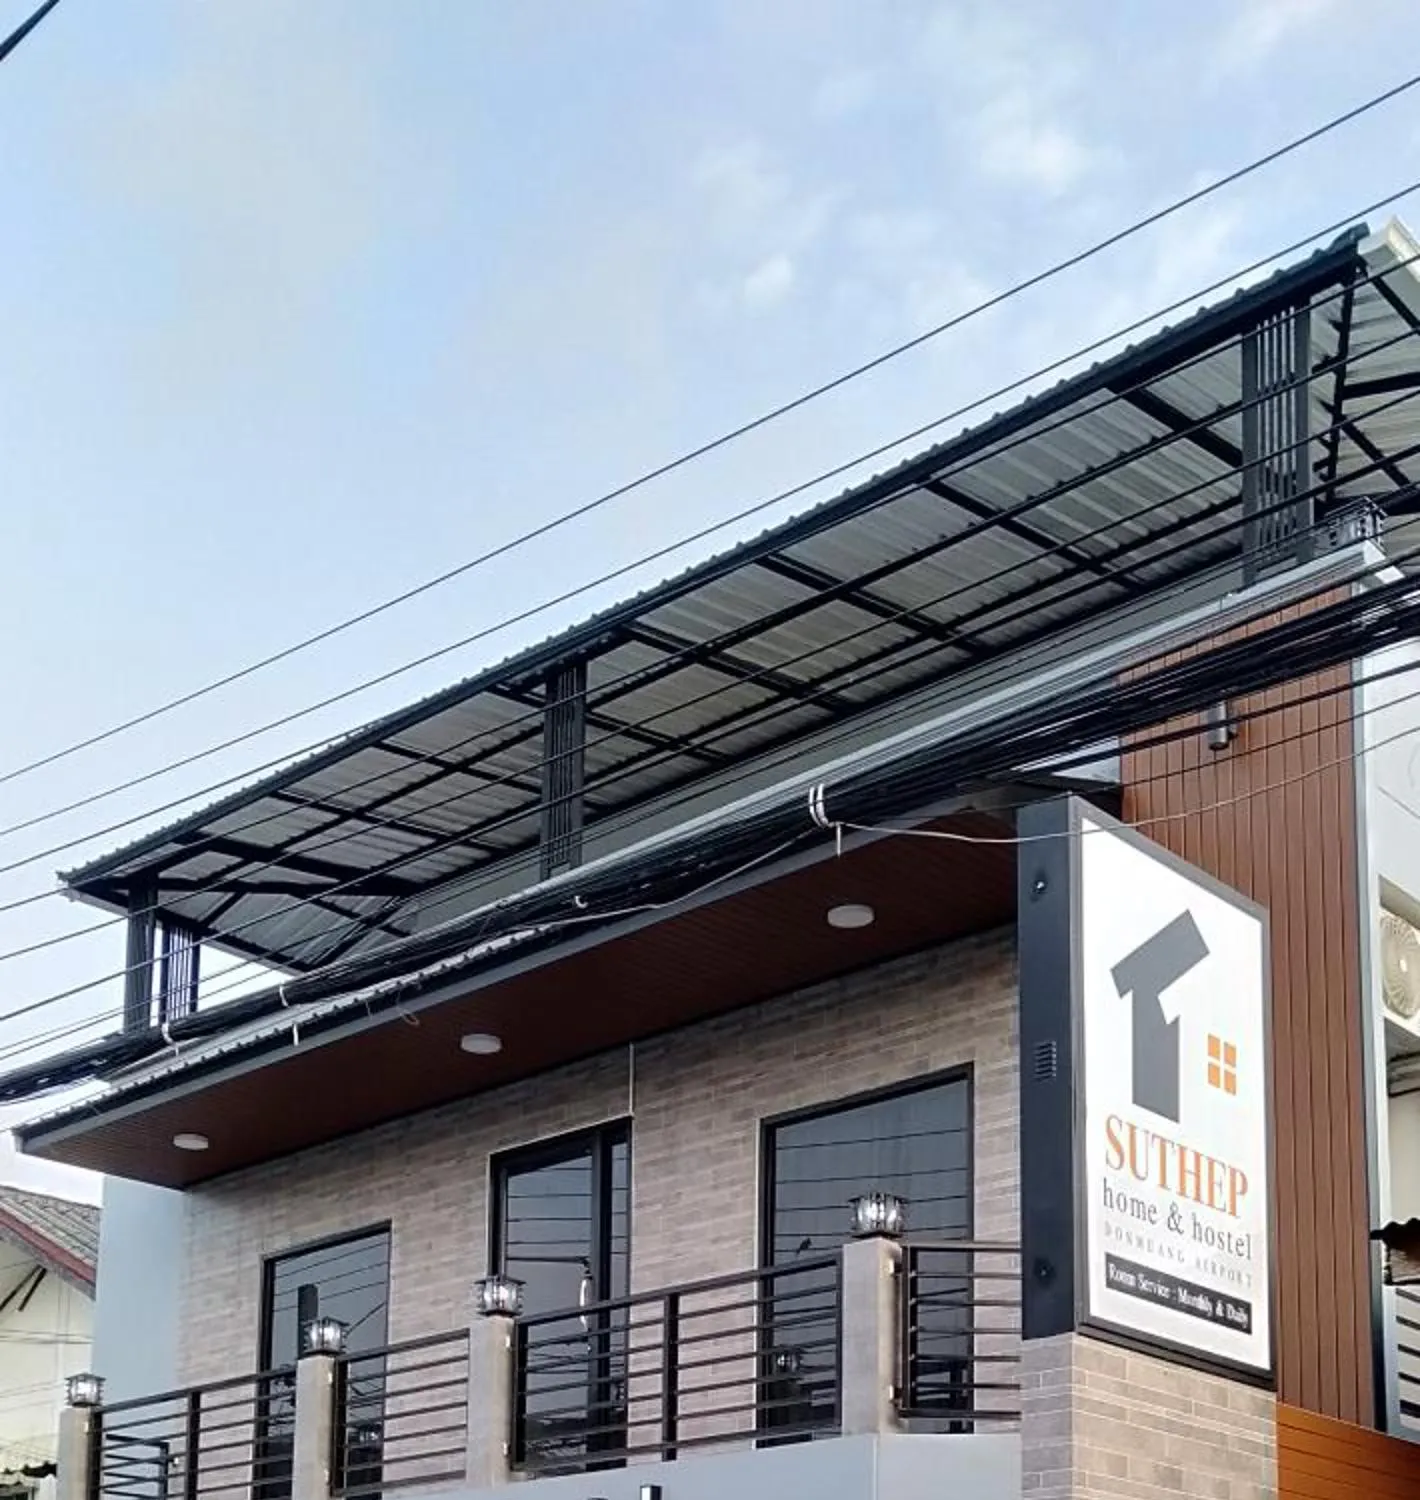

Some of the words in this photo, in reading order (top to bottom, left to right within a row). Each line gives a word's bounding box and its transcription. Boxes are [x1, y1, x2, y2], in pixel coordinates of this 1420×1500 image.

[1105, 1114, 1248, 1218] SUTHEP
[1103, 1178, 1157, 1226] home
[1167, 1202, 1184, 1235] &
[1192, 1212, 1252, 1260] hostel
[1104, 1220, 1185, 1263] DONMUANG
[1108, 1262, 1136, 1288] Room
[1137, 1272, 1171, 1299] Service
[1215, 1299, 1225, 1317] &
[1226, 1302, 1249, 1329] Daily
